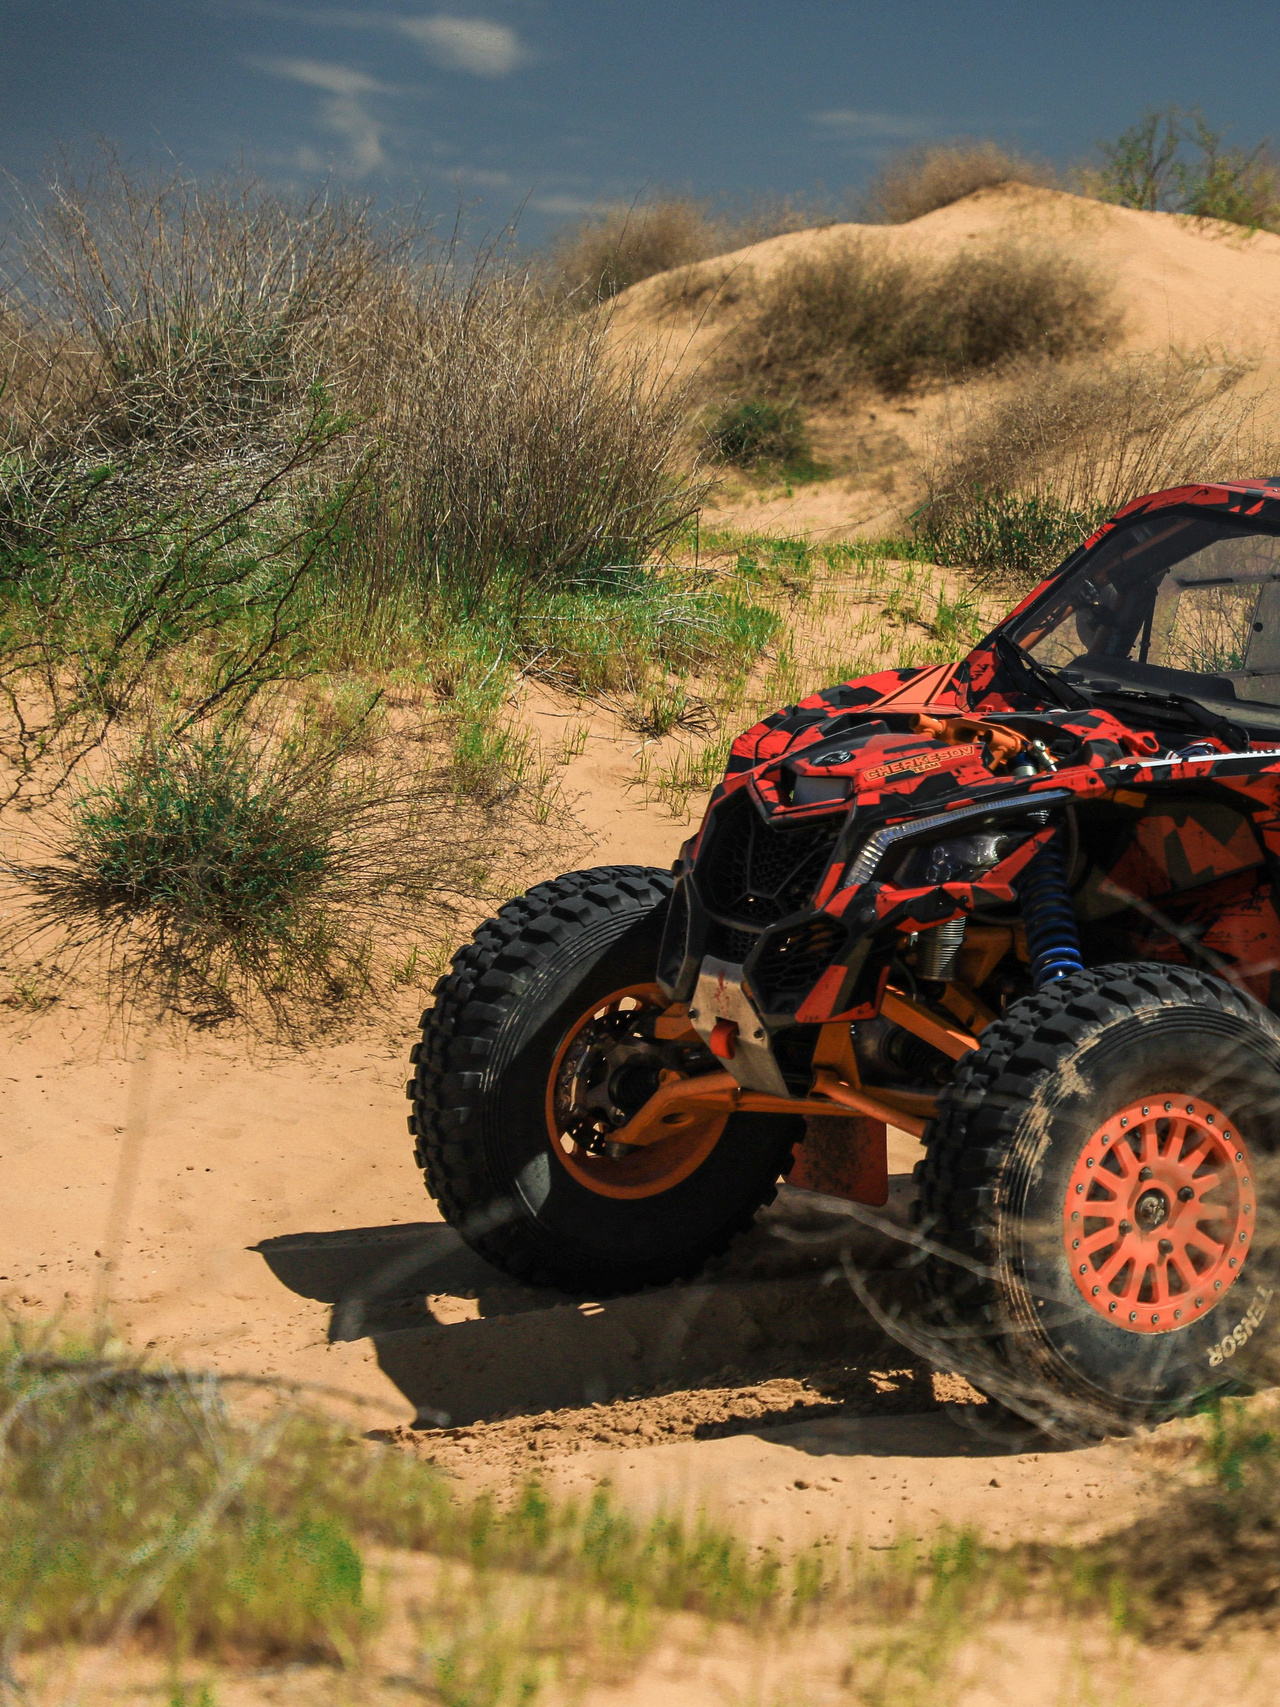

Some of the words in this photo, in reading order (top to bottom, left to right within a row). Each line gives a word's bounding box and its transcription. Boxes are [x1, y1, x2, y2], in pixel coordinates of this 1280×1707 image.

[864, 746, 974, 780] CHERKESOV
[913, 762, 940, 773] TEAM
[1206, 1285, 1274, 1367] TENSOR
